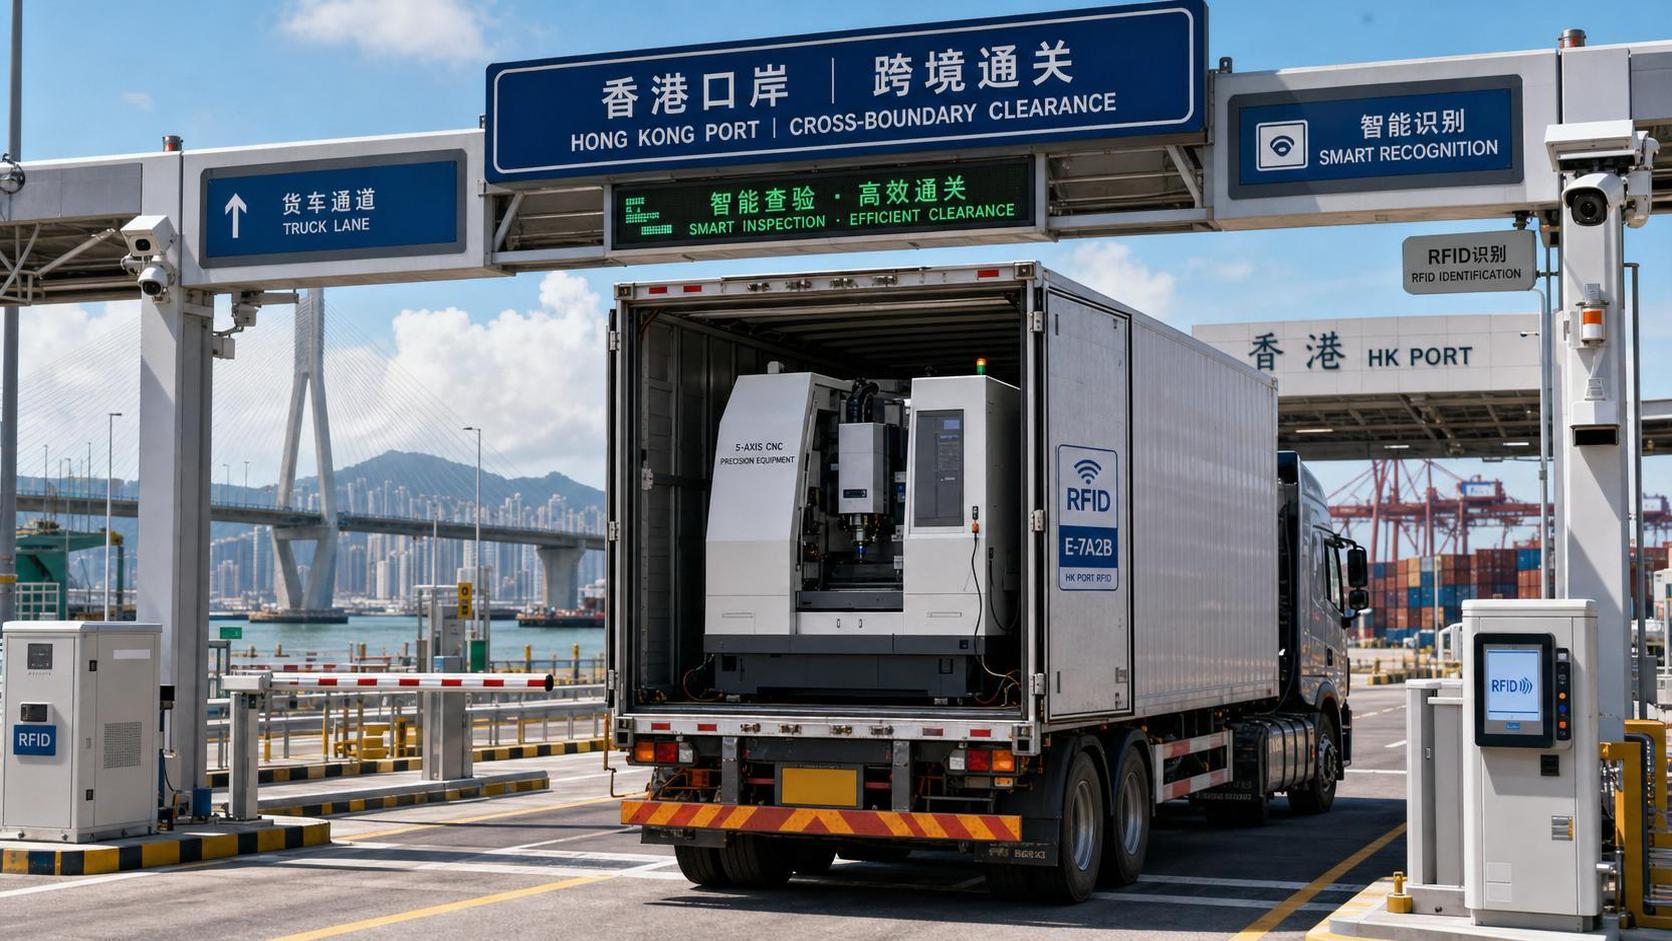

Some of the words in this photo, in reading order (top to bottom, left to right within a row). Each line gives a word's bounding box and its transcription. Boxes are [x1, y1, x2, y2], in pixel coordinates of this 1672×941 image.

[602, 64, 789, 119] 香港口岸
[873, 39, 1073, 97] 跨境通关
[571, 131, 627, 152] HONG
[638, 126, 695, 147] KONG
[706, 121, 760, 142] PORT
[790, 103, 977, 136] CROSS-BOUNDARY
[989, 92, 1117, 120] CLEARANCE
[1361, 108, 1466, 139] 智能识别
[1320, 147, 1374, 166] SMART
[1380, 139, 1498, 162] RECOGNITION
[282, 187, 375, 215] 货车通道
[711, 185, 816, 216] 智能查验
[859, 175, 967, 207] 高效通关
[282, 219, 326, 235] TRUCK
[334, 217, 370, 232] LANE
[690, 220, 735, 236] SMART
[743, 215, 826, 232] INSPECTION
[850, 209, 921, 226] EFFICIENT
[929, 202, 1015, 220] CLEARANCE
[1429, 244, 1507, 265] RFID识别
[1411, 272, 1436, 283] RFID
[1439, 268, 1522, 282] IDENTIFICATION
[1249, 330, 1346, 372] 香港
[1369, 348, 1400, 368] HK
[1411, 346, 1473, 367] PORT
[736, 442, 763, 452] 5-AXIS
[765, 442, 784, 451] CNC
[756, 455, 795, 465] EQUIPMENT
[1066, 487, 1111, 512] RFID
[1065, 537, 1113, 557] E-7A2B
[1065, 573, 1076, 582] HK
[1076, 573, 1095, 583] PORT
[1096, 573, 1112, 583] RFID
[1491, 679, 1518, 693] RFID
[18, 732, 51, 746] RFID
